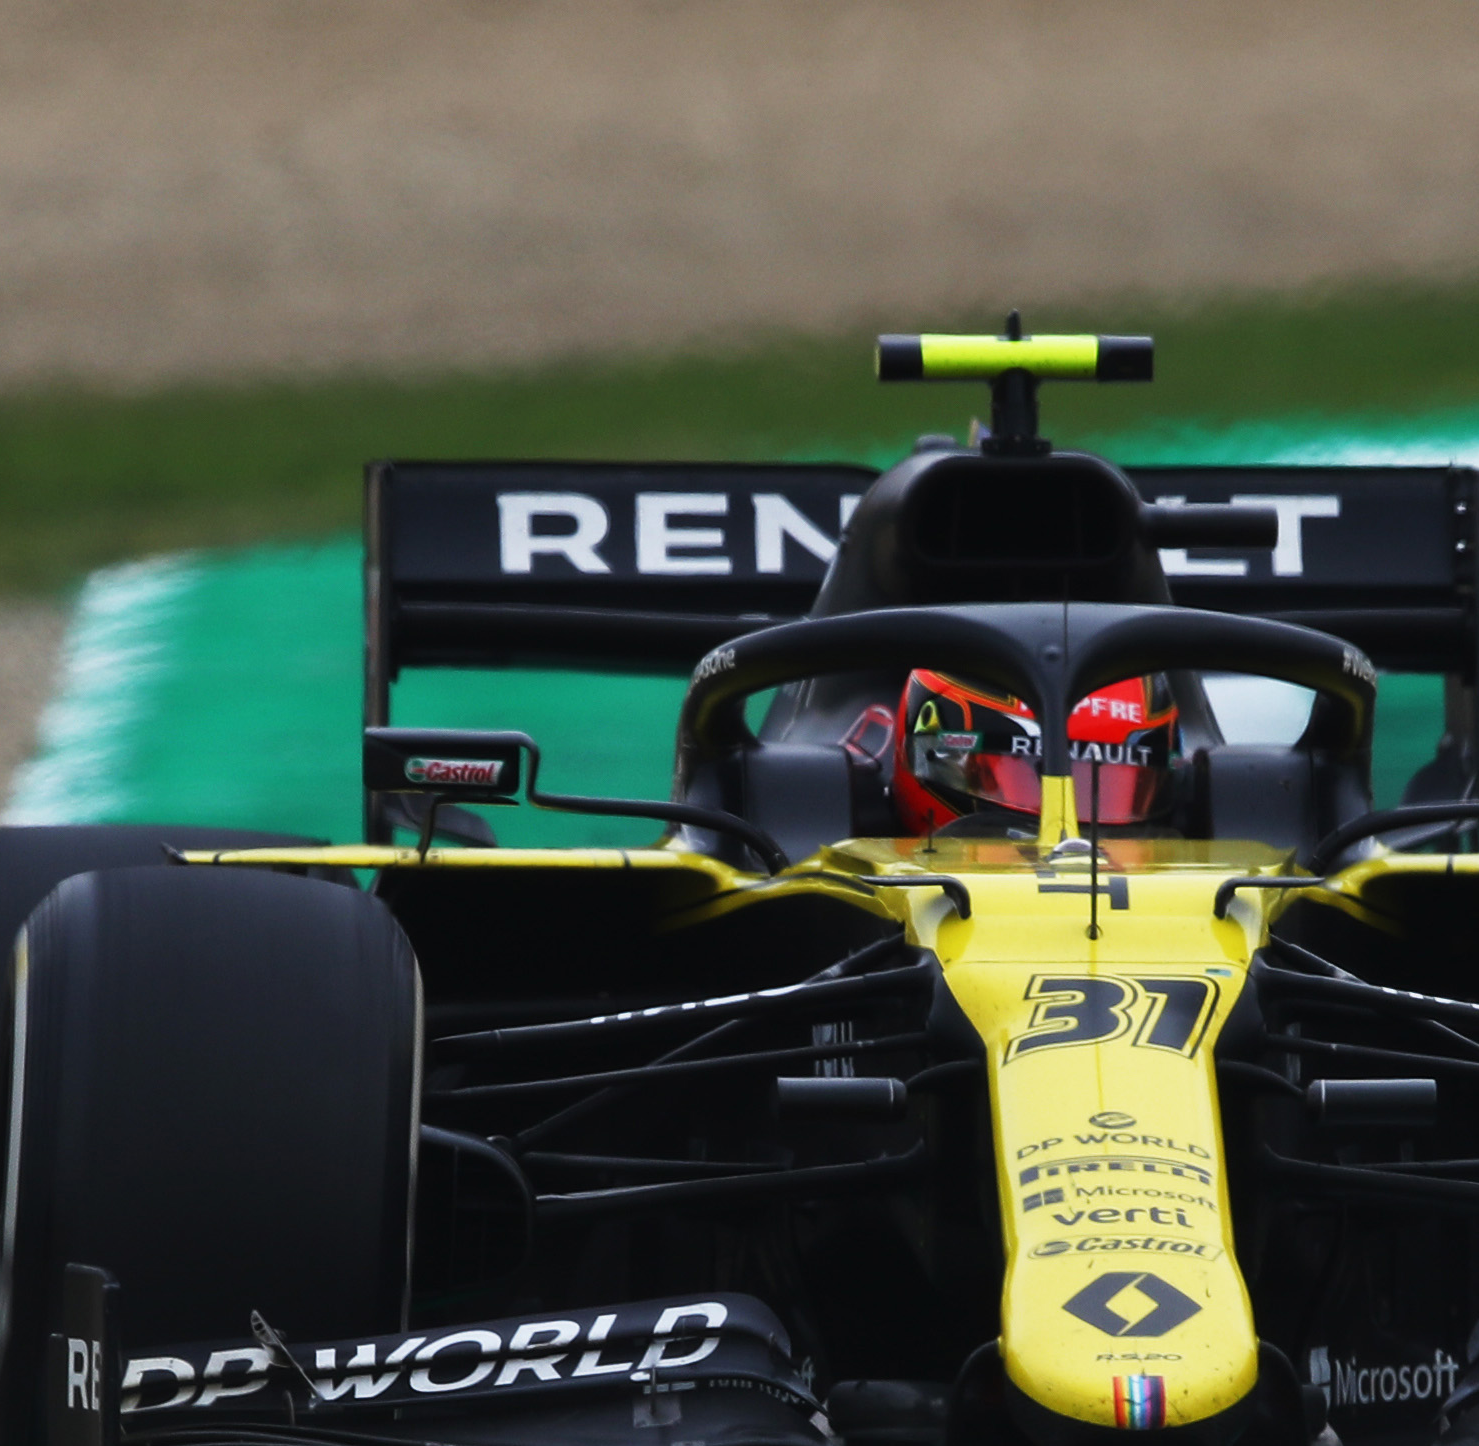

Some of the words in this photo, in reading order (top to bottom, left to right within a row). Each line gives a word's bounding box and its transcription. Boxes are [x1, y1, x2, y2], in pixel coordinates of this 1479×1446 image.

[496, 491, 1340, 576] RENLT
[425, 762, 495, 782] Castrol
[1003, 973, 1220, 1067] 31
[1017, 1137, 1064, 1160] DP
[1073, 1132, 1211, 1159] WORLD
[1019, 1155, 1213, 1187] PIRELLI
[1076, 1186, 1218, 1212] Microsoft
[1052, 1207, 1194, 1229] verti
[1075, 1237, 1207, 1257] Castrol
[121, 1347, 271, 1413] DP
[315, 1302, 729, 1400] WORLD
[1335, 1348, 1460, 1406] Microsoft
